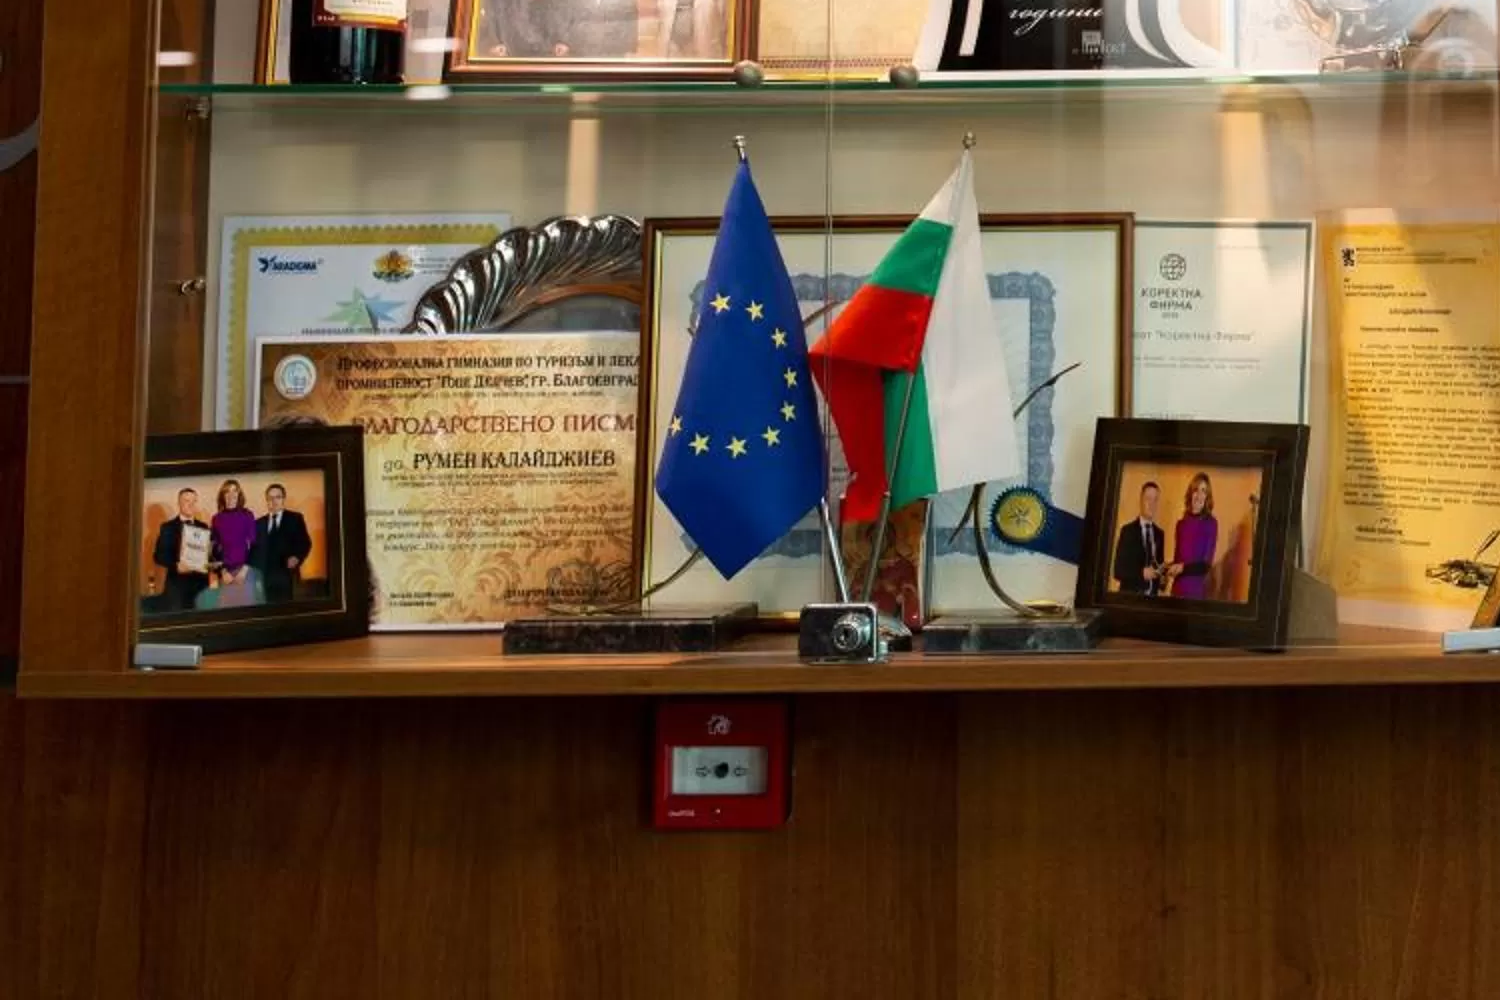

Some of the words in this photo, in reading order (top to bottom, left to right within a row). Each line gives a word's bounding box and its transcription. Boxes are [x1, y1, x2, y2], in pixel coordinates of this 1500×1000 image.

[1008, 6, 1103, 37] години
[1140, 287, 1202, 298] КОРЕКТНА
[1150, 300, 1193, 310] ФИРМА
[337, 355, 445, 371] ПРОФЕСИОНАЛНА
[447, 355, 513, 369] ГИМНАЗИЯ
[515, 355, 533, 368] ПО
[536, 355, 595, 368] ТУРИЗЪМ
[597, 355, 605, 367] И
[563, 413, 635, 433] ПИСМ
[413, 451, 476, 470] РУМЕН
[480, 448, 616, 470] КАЛАЙДЖИЕВ
